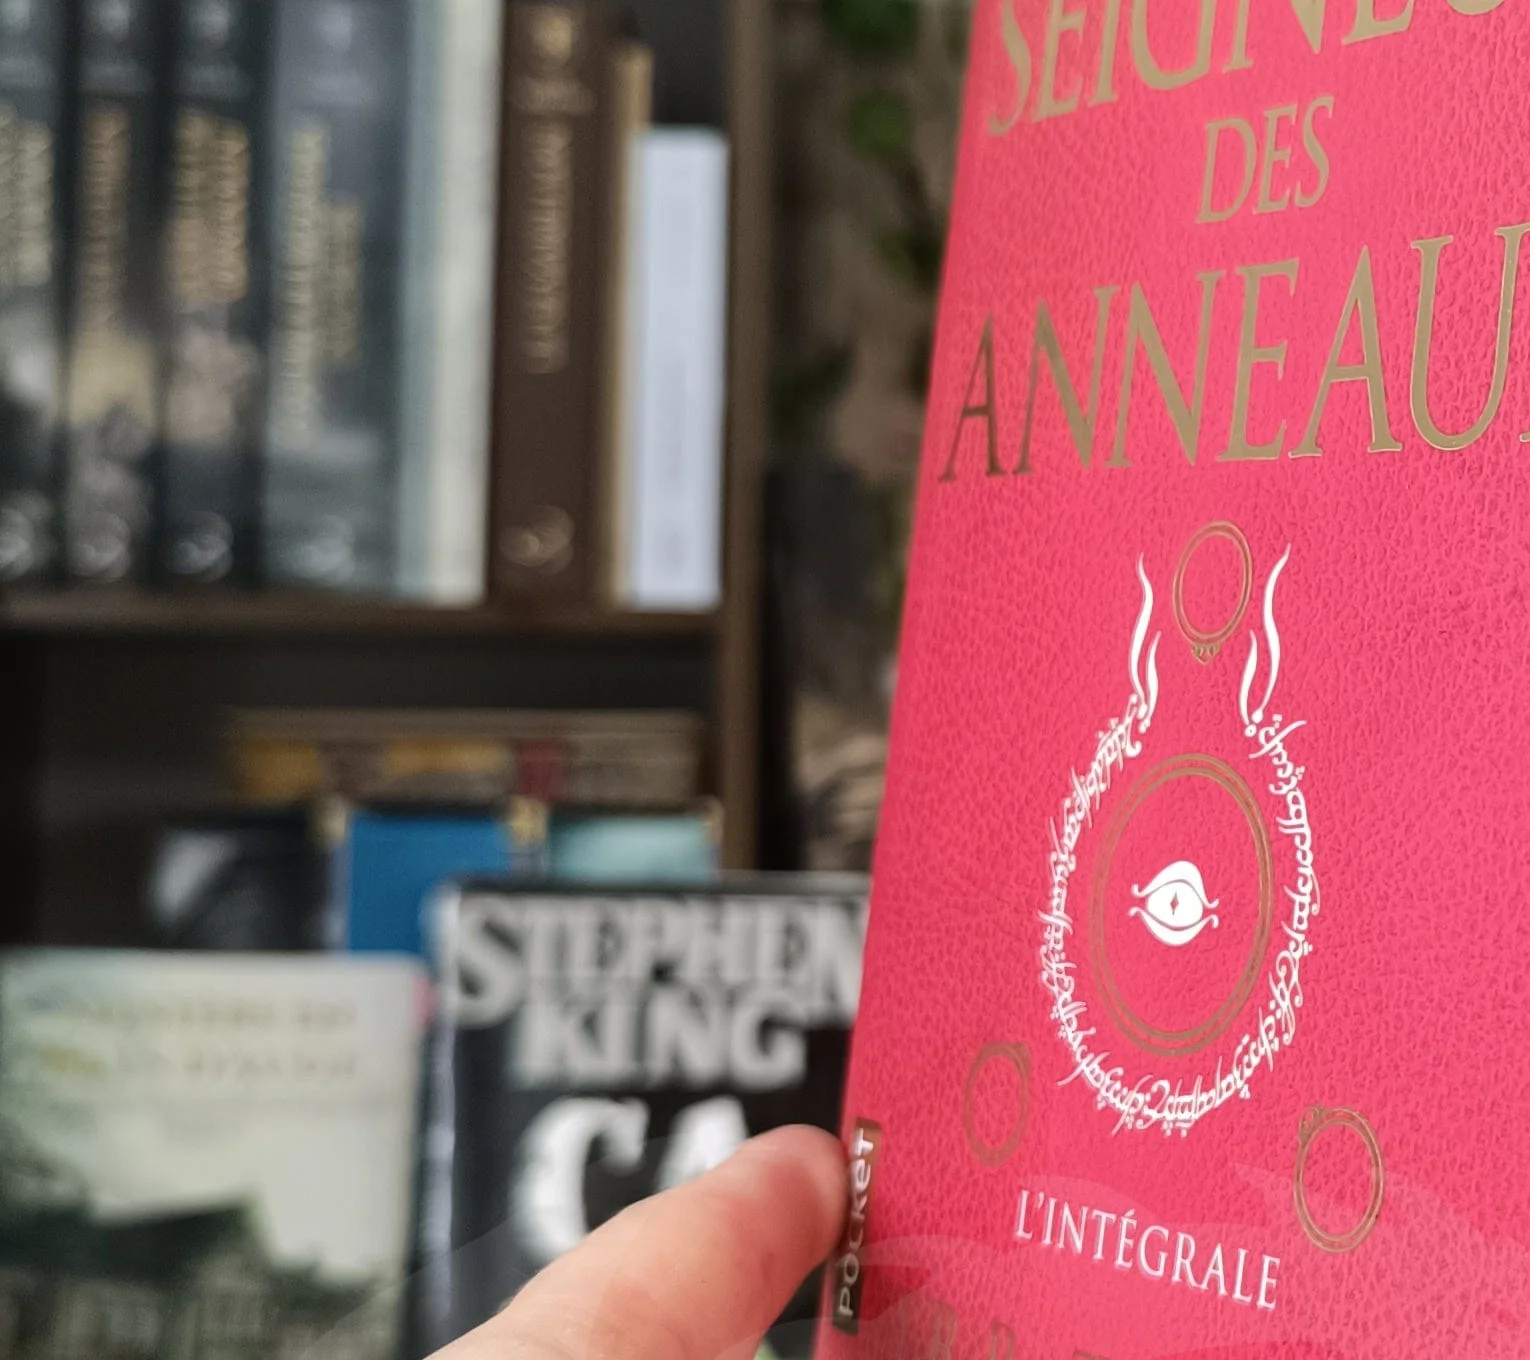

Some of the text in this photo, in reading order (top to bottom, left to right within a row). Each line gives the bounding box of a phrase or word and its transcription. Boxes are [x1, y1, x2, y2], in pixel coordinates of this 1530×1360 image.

[1195, 96, 1334, 224] DES
[457, 892, 870, 1028] STEPHEN
[513, 985, 806, 1089] KING
[1015, 1189, 1281, 1310] L'INTÉGRALE
